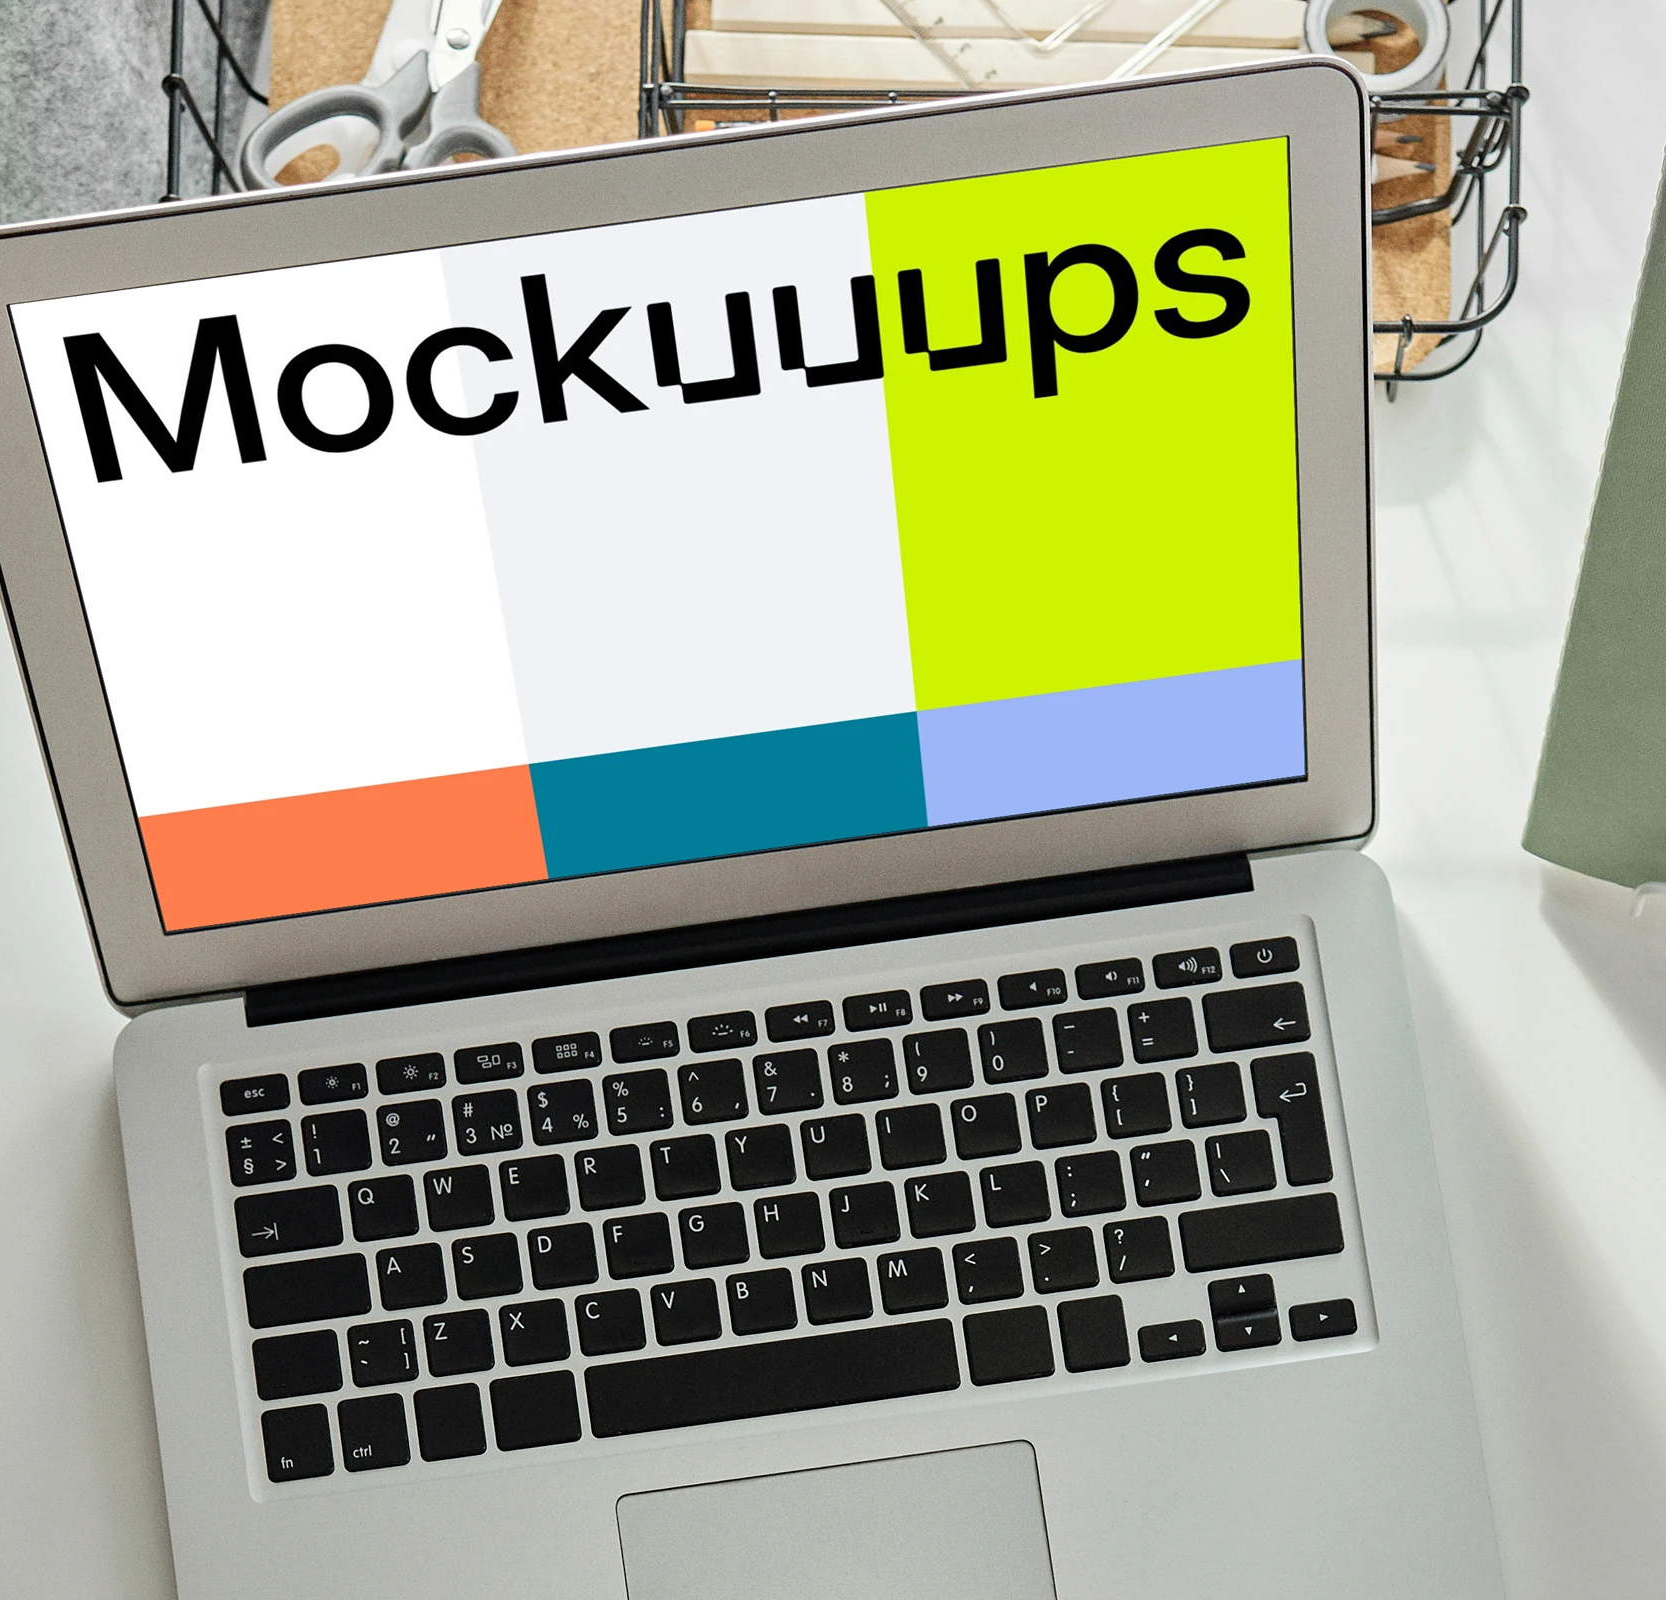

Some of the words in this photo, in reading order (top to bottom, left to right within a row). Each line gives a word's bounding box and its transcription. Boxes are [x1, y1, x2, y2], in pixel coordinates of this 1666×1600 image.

[63, 229, 1250, 482] Mockuuups
[243, 1088, 265, 1099] esc
[351, 1082, 361, 1091] F1
[428, 1071, 439, 1080] F2
[506, 1061, 518, 1070] F3
[584, 1050, 595, 1059] F4
[662, 1039, 674, 1048] F5
[739, 1029, 751, 1038] F6
[817, 1019, 828, 1028] F7
[895, 1008, 907, 1017] F8
[972, 997, 984, 1006] F9
[1046, 986, 1062, 996] F10
[1126, 976, 1140, 986] F11
[1201, 965, 1216, 975] F12
[313, 1148, 322, 1165] 1
[388, 1137, 401, 1155] 2
[465, 1127, 478, 1144] 3
[541, 1116, 554, 1133] 4
[572, 1113, 590, 1129] %
[617, 1106, 628, 1124] 5
[691, 1096, 703, 1113] 6
[766, 1085, 778, 1103] 7
[841, 1076, 854, 1093] 8
[916, 1065, 928, 1083] 9
[385, 1112, 401, 1127] @
[462, 1102, 474, 1118] #
[537, 1090, 549, 1109] $
[612, 1081, 629, 1098] %
[763, 1060, 778, 1077] &
[357, 1187, 375, 1205] Q
[432, 1176, 453, 1196] W
[508, 1166, 520, 1185] E
[583, 1156, 597, 1175] R
[659, 1146, 671, 1164] T
[734, 1135, 748, 1154] Y
[809, 1125, 826, 1144] U
[961, 1104, 978, 1123] O
[1035, 1094, 1048, 1113] P
[386, 1256, 402, 1275] A
[461, 1246, 475, 1264] S
[537, 1235, 552, 1254] D
[612, 1225, 623, 1244] F
[688, 1214, 705, 1233] G
[763, 1203, 780, 1223] H
[841, 1194, 850, 1213] J
[914, 1183, 930, 1202] K
[989, 1173, 1002, 1191] L
[433, 1321, 448, 1341] Z
[508, 1311, 525, 1331] X
[585, 1301, 601, 1320] C
[660, 1290, 675, 1310] V
[735, 1281, 750, 1300] B
[811, 1269, 828, 1289] N
[888, 1258, 908, 1279] M
[1113, 1228, 1124, 1245] ?
[280, 1456, 294, 1469] fn
[352, 1444, 373, 1459] ctrl
